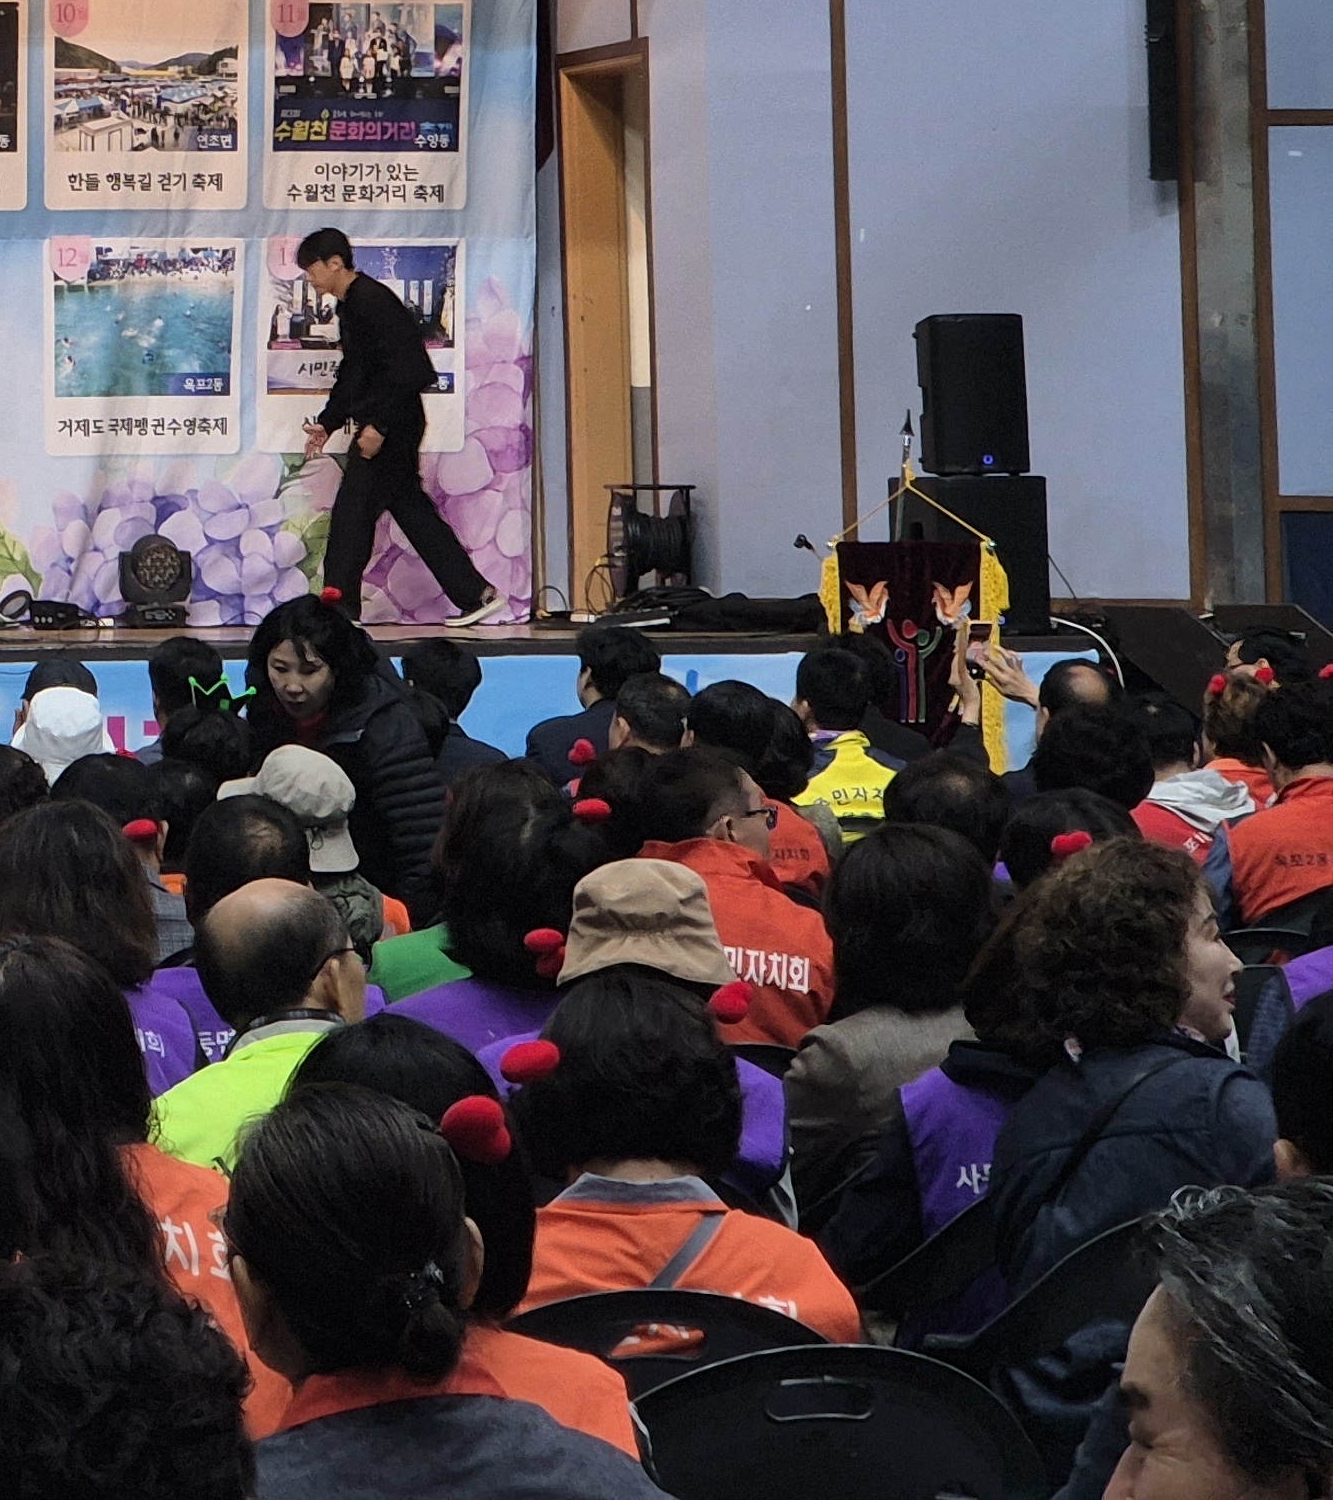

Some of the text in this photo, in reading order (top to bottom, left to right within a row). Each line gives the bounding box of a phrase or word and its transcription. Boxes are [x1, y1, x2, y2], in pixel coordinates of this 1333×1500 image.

[275, 120, 327, 142] 수월천
[329, 121, 416, 142] 문화의거리
[68, 172, 223, 192] 한들 행복길 걷기 축제
[314, 163, 419, 182] 이야기가 있는
[287, 184, 444, 203] 수월천 문화거리 축제
